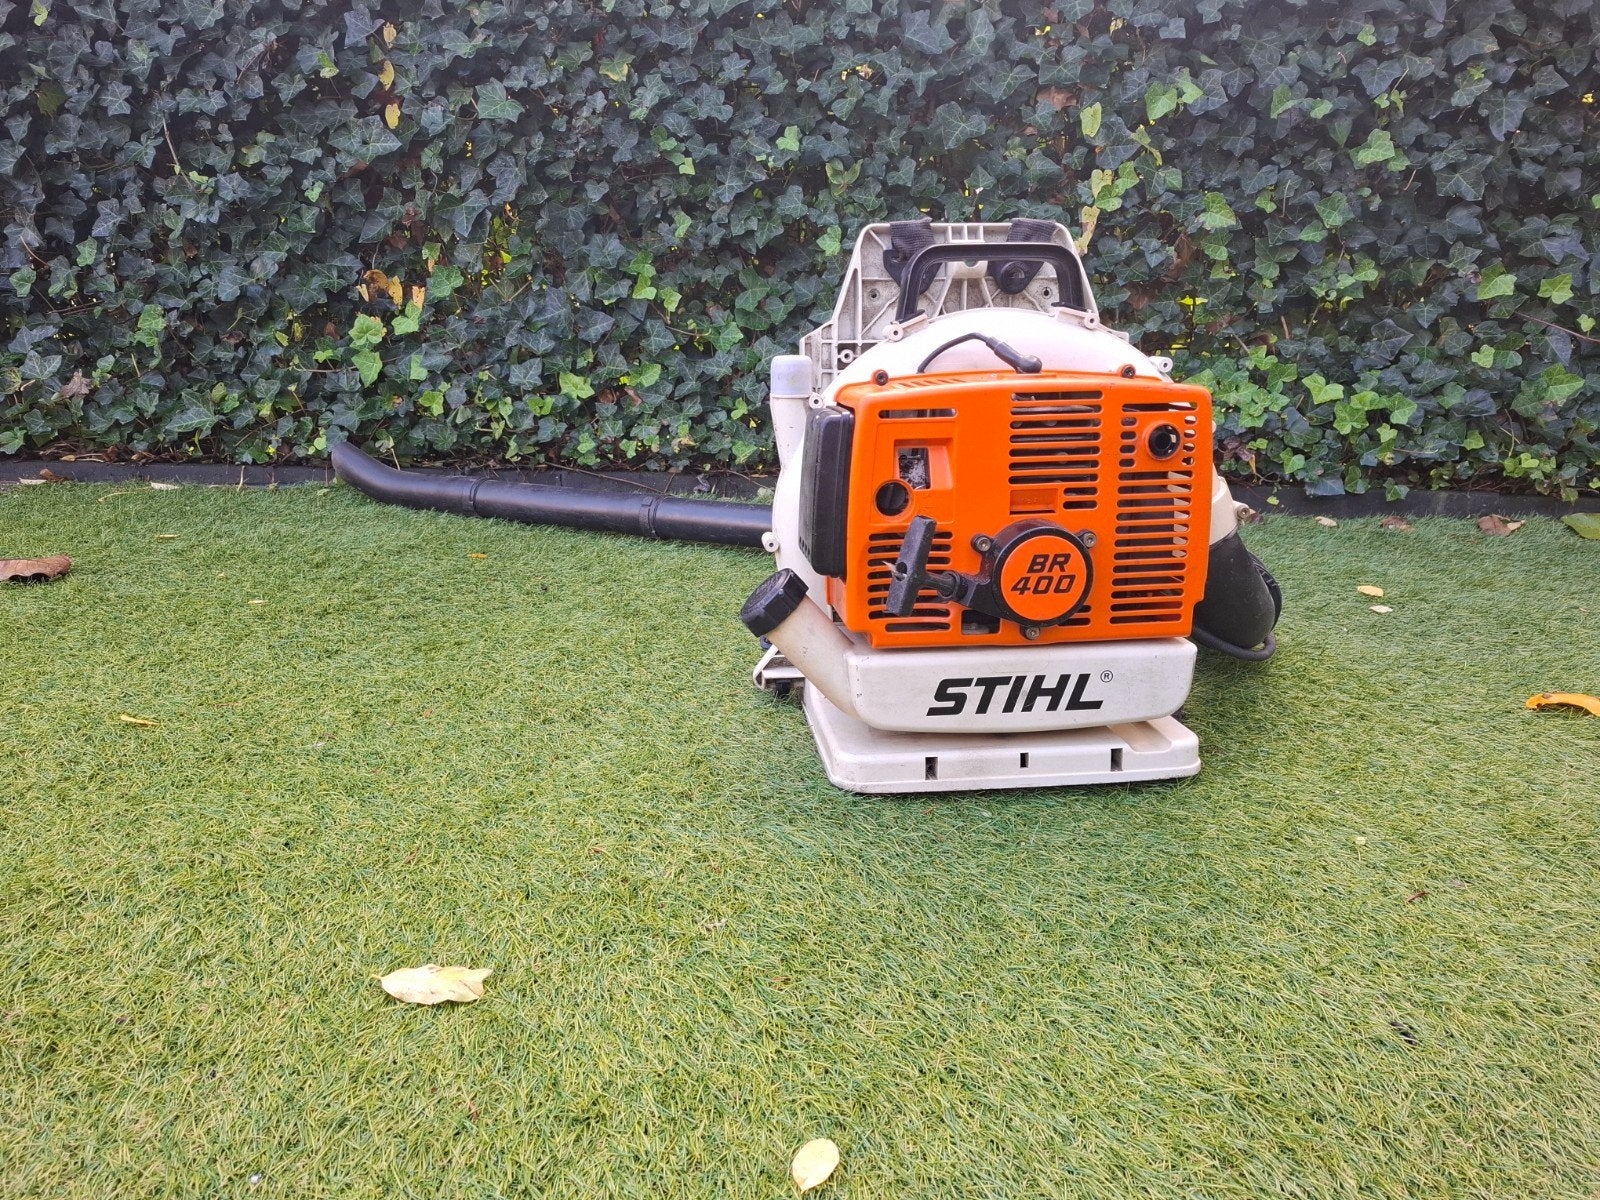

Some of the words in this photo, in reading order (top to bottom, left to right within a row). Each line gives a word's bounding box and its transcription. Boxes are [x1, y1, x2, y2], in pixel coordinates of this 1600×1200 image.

[1027, 553, 1071, 573] BR
[1011, 575, 1076, 595] 400
[926, 673, 1104, 716] STIHL
